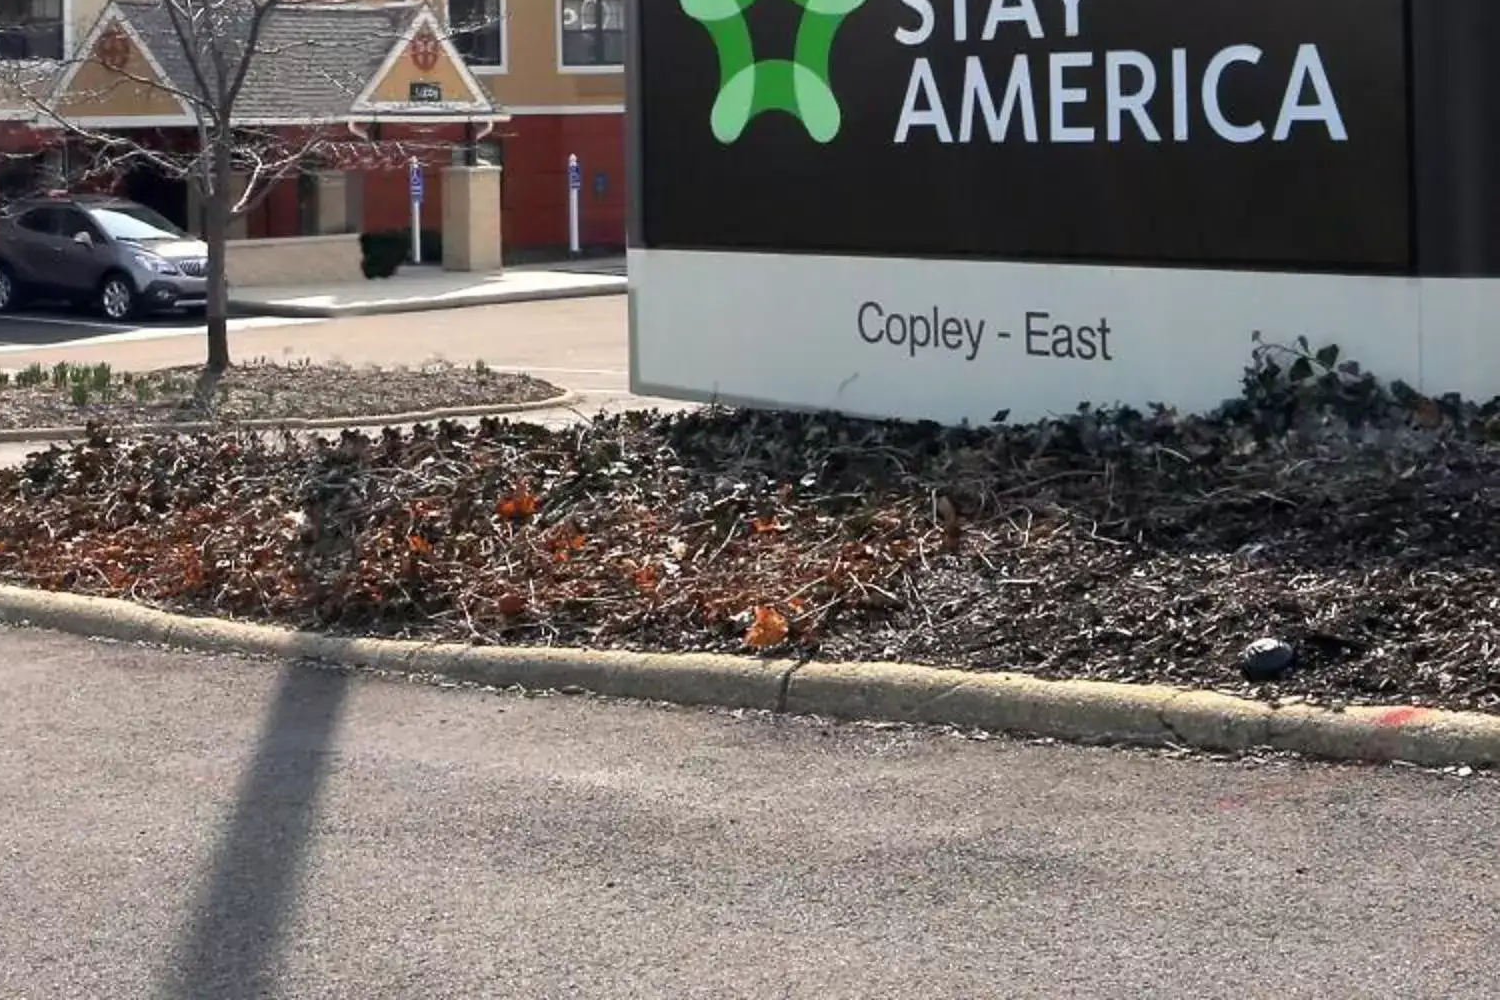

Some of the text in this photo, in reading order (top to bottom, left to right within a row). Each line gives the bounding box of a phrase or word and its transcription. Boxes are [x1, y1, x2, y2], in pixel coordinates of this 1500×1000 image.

[894, 44, 1348, 143] AMERICA
[857, 301, 985, 361] Copley
[1025, 311, 1113, 361] East
